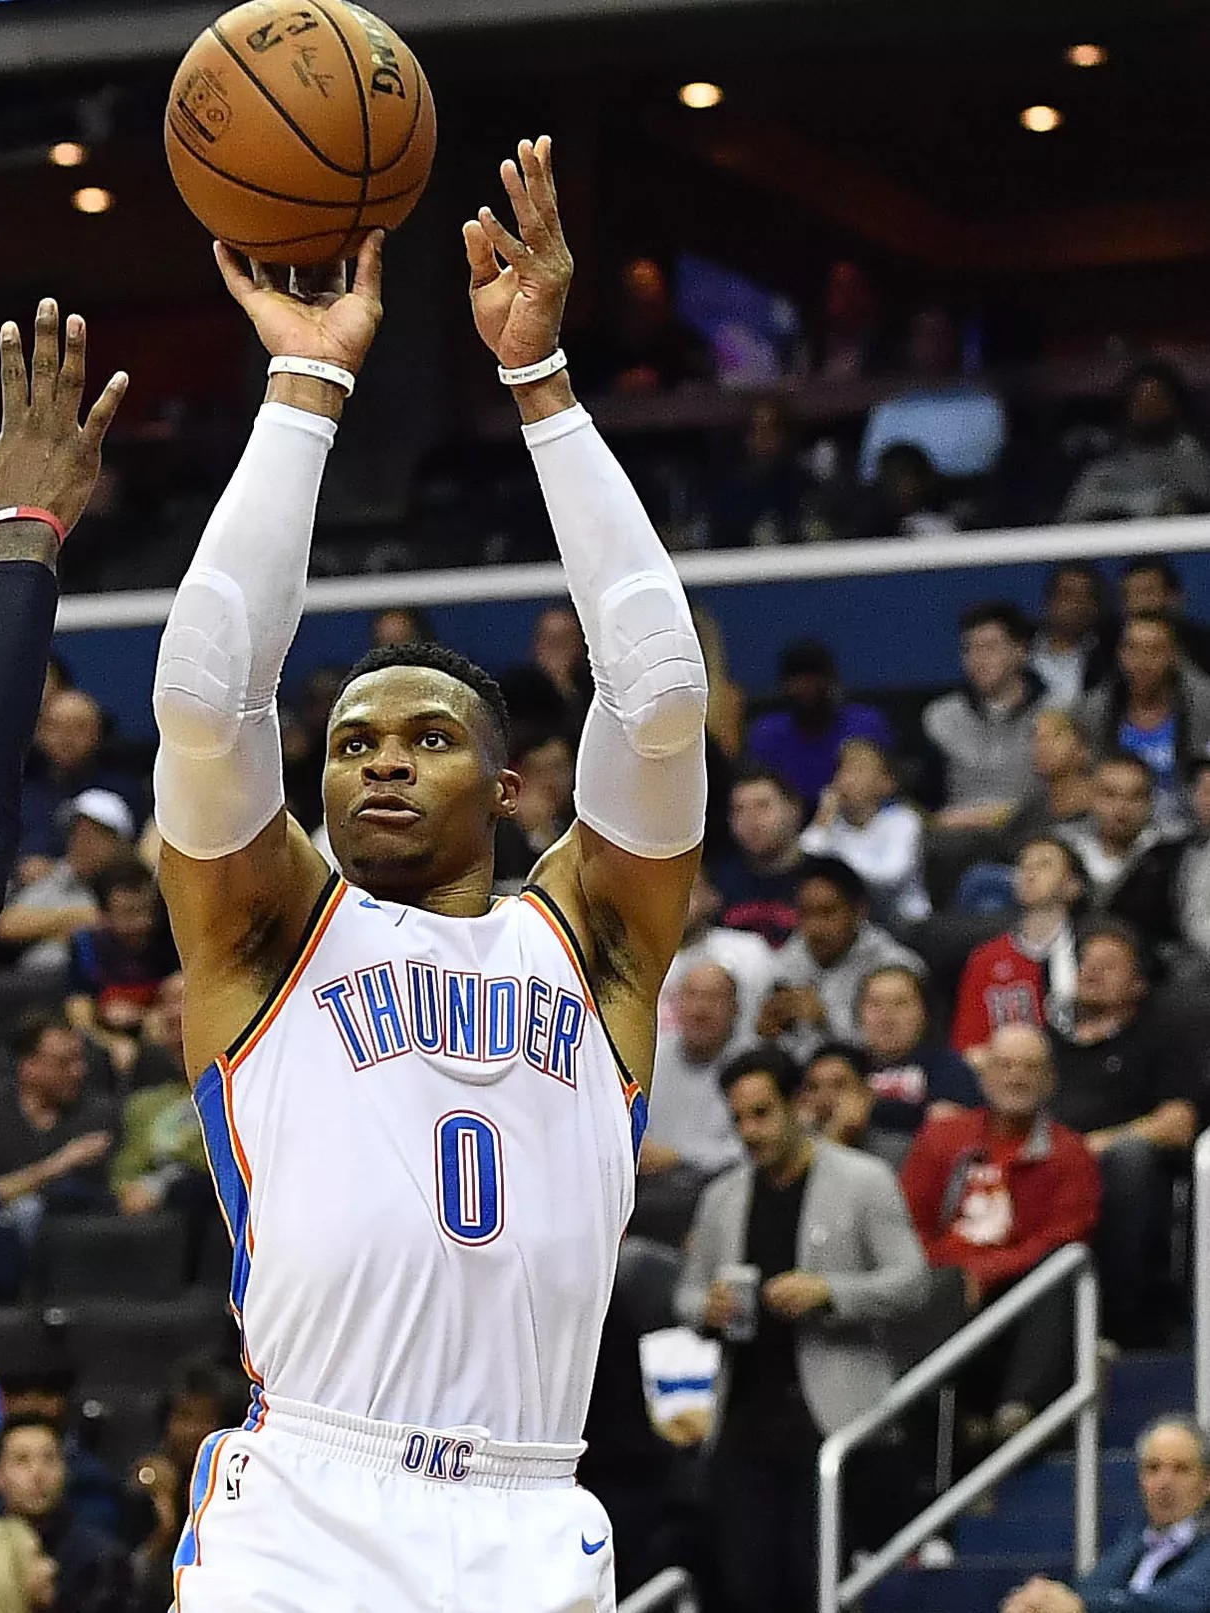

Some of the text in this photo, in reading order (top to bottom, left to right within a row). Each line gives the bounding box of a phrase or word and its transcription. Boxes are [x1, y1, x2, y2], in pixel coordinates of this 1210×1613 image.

[312, 959, 587, 1091] THUNDER
[434, 1109, 505, 1247] 0
[401, 1430, 474, 1481] OKC
